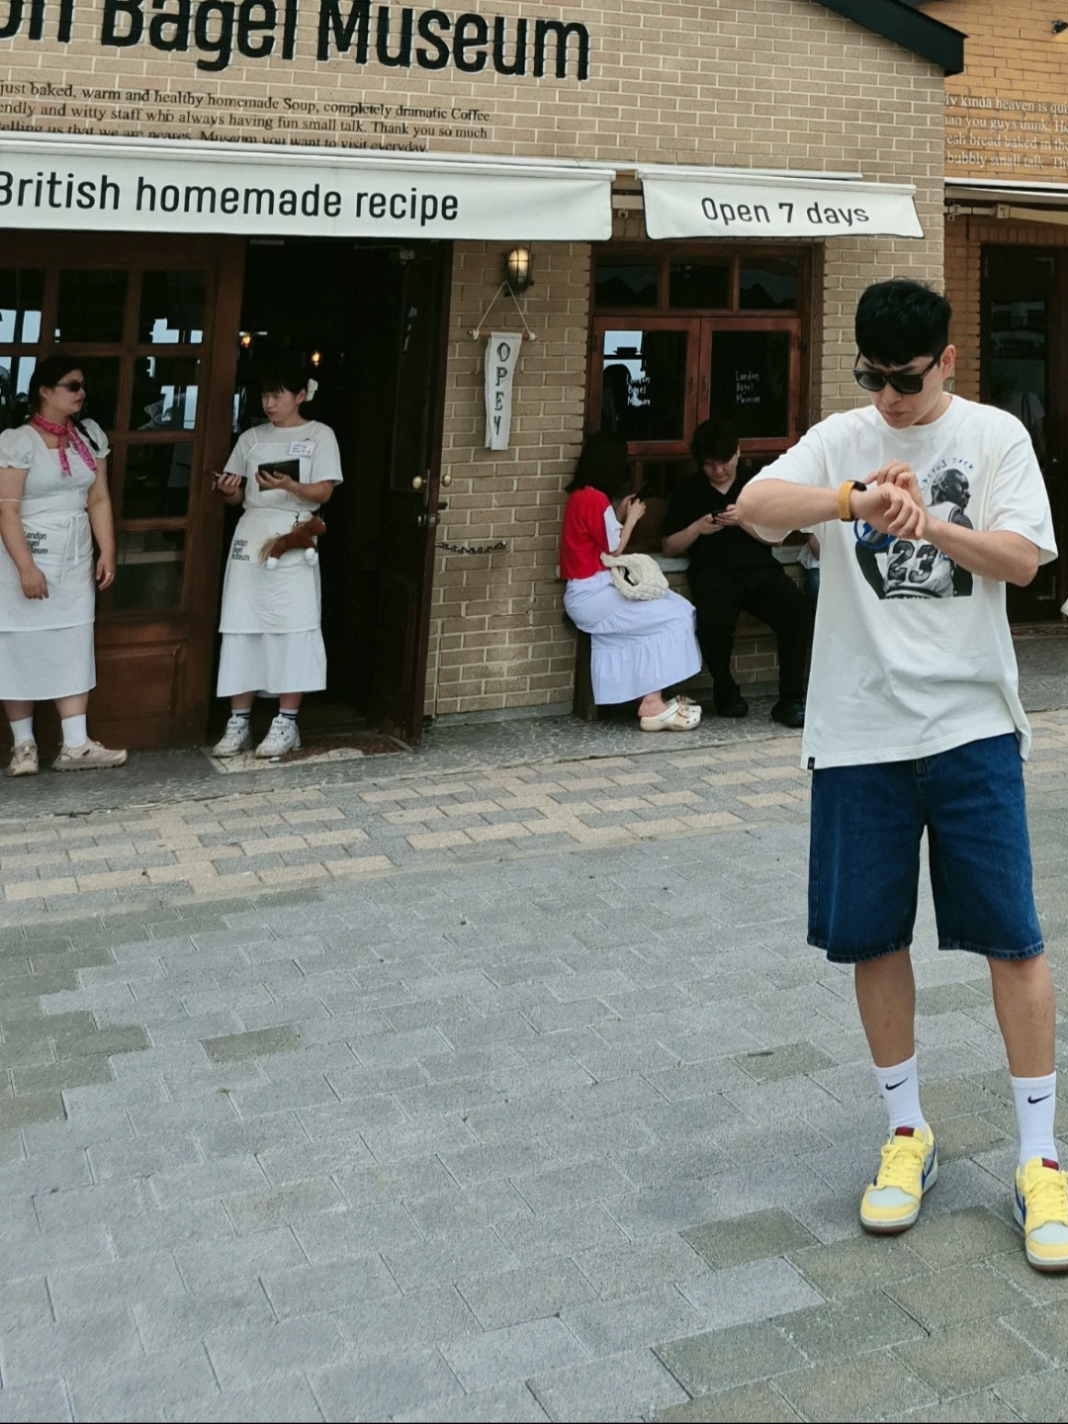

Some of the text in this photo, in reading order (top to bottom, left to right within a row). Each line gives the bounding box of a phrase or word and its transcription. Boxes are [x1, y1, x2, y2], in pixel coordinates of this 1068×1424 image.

[0, 80, 493, 122] just baked, warm and healthy homemade Soup, completely dramatic Coffee.
[961, 94, 992, 109] kinda
[995, 95, 1035, 112] heaven
[1038, 99, 1048, 113] is
[0, 121, 43, 131] elling
[324, 138, 336, 148] to
[341, 138, 367, 149] visit
[40, 103, 66, 117] and
[71, 105, 107, 121] witty
[110, 107, 143, 120] staff
[145, 108, 175, 122] who
[178, 109, 225, 127] always
[229, 111, 273, 129] having
[278, 116, 298, 128] fun
[302, 119, 336, 131] small
[340, 120, 367, 133] talk.
[371, 121, 409, 135] Thank
[413, 124, 434, 138] you
[438, 127, 452, 136] so
[455, 126, 488, 138] much
[965, 117, 987, 128] you
[990, 118, 1016, 133] guys
[945, 132, 966, 145] esh
[969, 133, 1001, 147] bread
[1004, 135, 1037, 149] baked
[1040, 137, 1051, 150] in
[947, 151, 987, 168] bubbly
[990, 153, 1020, 167] small
[0, 171, 459, 227] British homemade recipe
[700, 197, 870, 227] Open 7 days
[889, 540, 938, 584] 23
